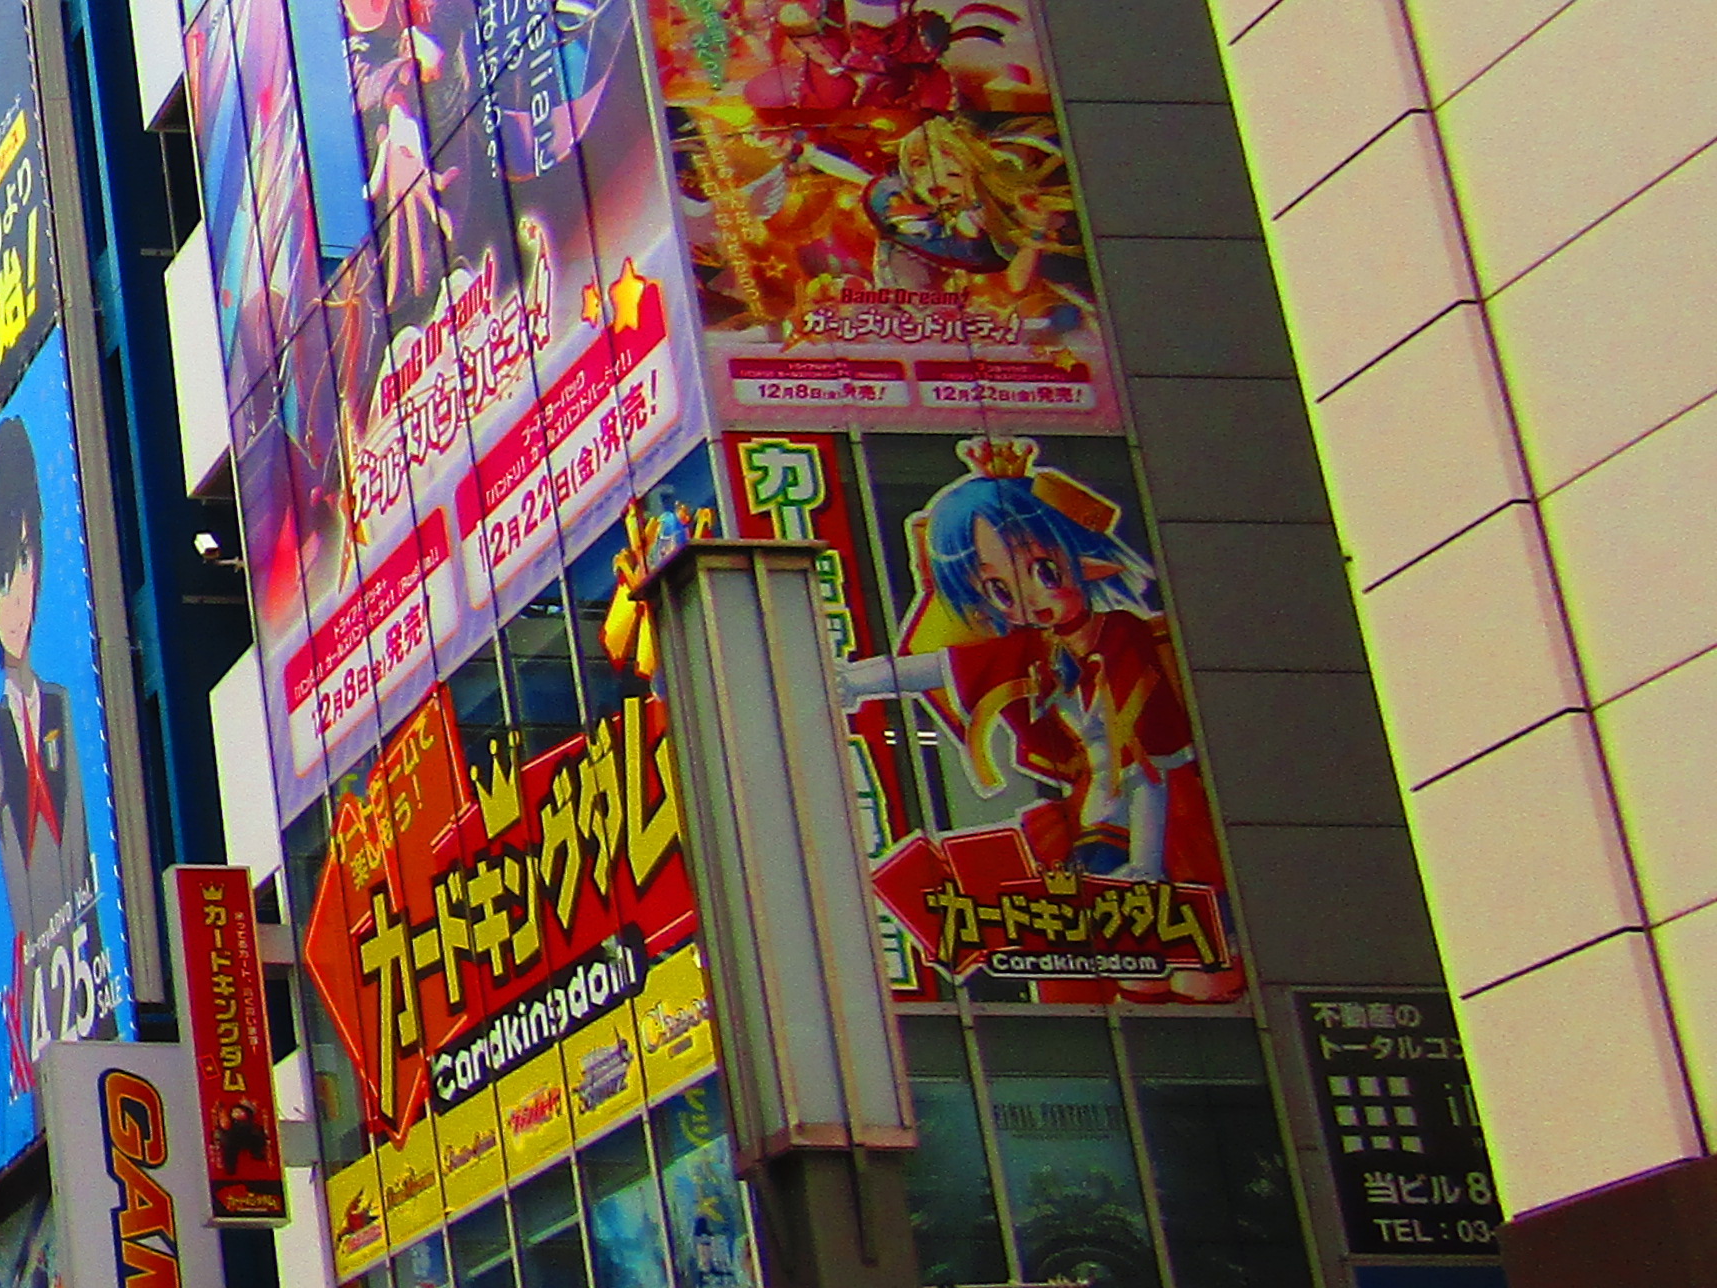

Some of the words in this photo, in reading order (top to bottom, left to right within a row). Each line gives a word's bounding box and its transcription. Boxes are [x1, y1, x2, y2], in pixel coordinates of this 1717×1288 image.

[927, 880, 1217, 969] カードキングダム
[92, 946, 113, 986] ON
[96, 976, 122, 1017] SALE
[202, 902, 248, 1094] カードキングダム
[1363, 1173, 1459, 1207] 当ビル
[1467, 1173, 1492, 1207] 8
